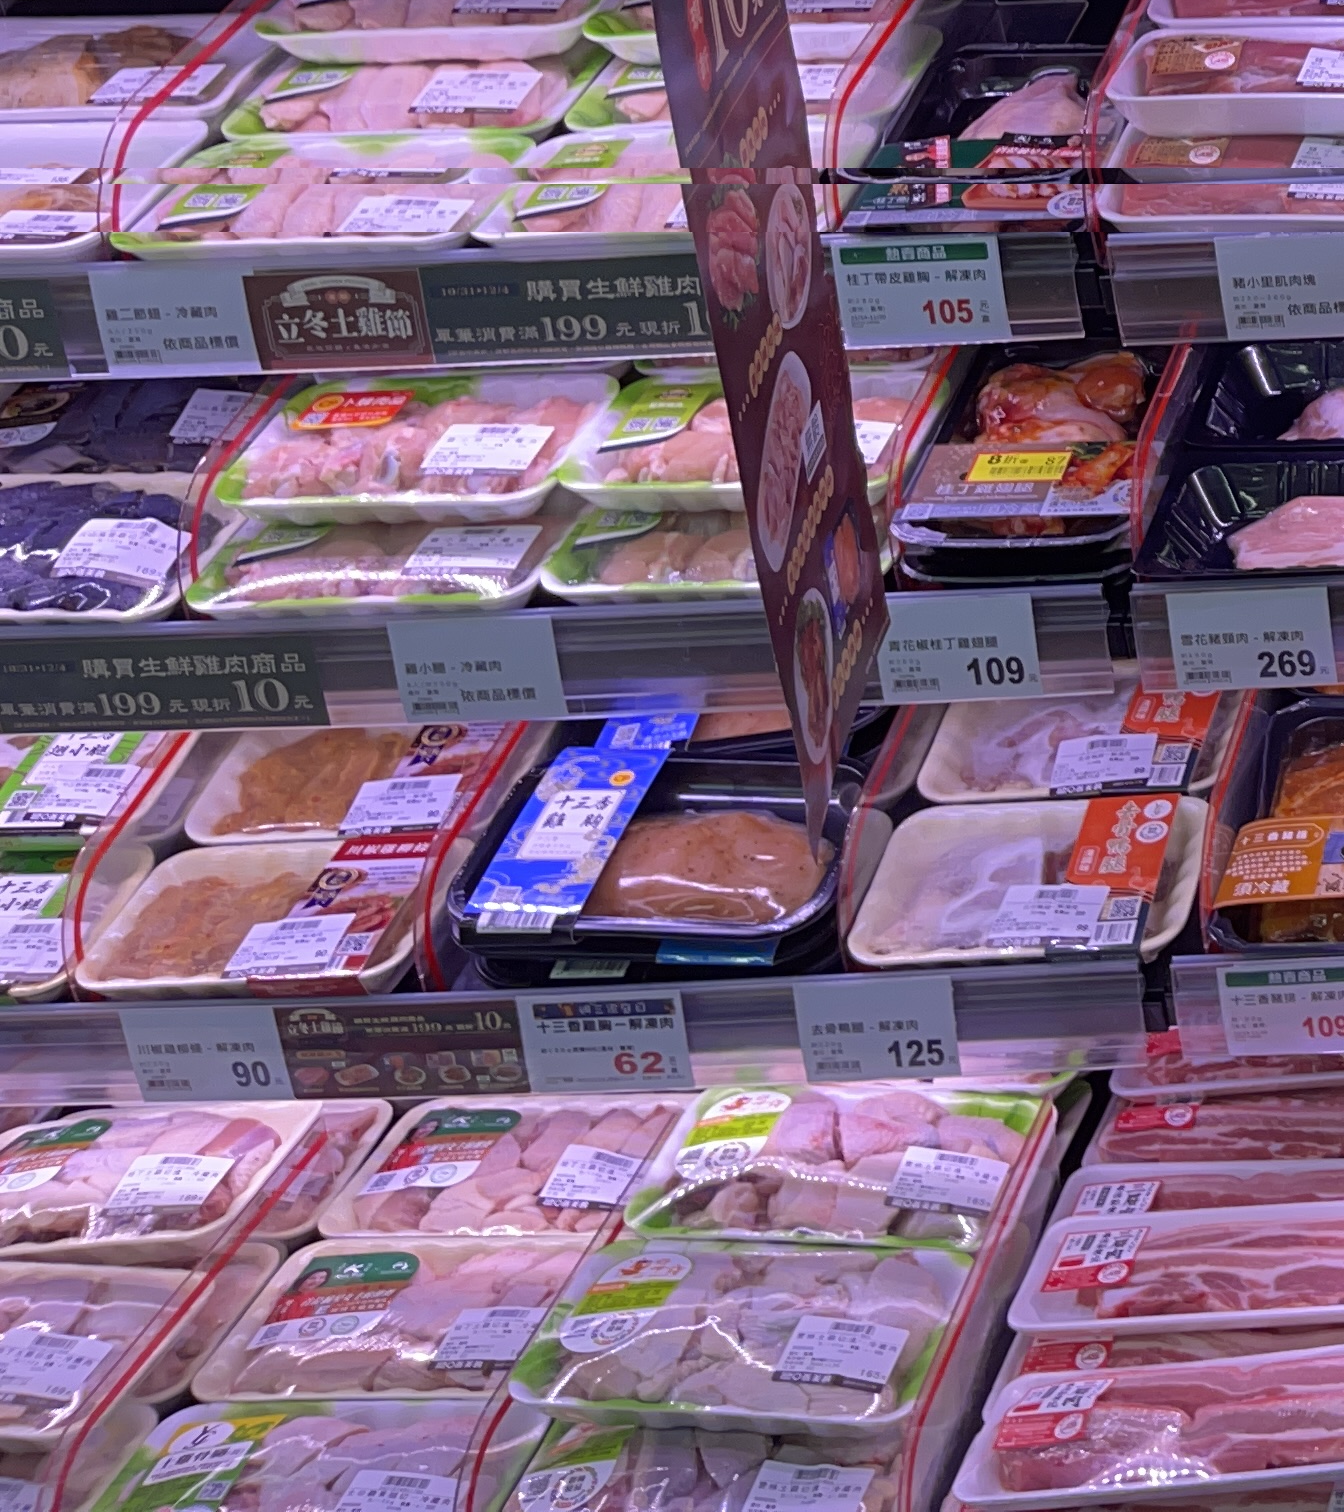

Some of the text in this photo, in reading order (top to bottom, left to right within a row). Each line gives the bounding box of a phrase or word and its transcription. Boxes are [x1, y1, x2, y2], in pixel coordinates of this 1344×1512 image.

[886, 246, 947, 261] 熱賣商品
[526, 274, 700, 302] 購買生鮮雞肉
[846, 268, 987, 286] 桂丁帶皮雞胸 解凍肉
[1232, 274, 1316, 289] 豬小里肌肉塊
[175, 306, 218, 319] 冷藏肉
[923, 299, 974, 325] 105
[275, 306, 413, 344] 立冬土雞節
[435, 325, 539, 343] 單筆消費滿
[540, 315, 607, 342] 199
[616, 322, 635, 337] 元
[640, 320, 680, 335] 現折
[163, 335, 239, 351] 依商品標價
[82, 652, 306, 680] 購買生鮮雞肉商品
[459, 660, 502, 673] 冷藏肉
[967, 656, 1025, 686] 109
[1257, 649, 1317, 678] 269
[98, 690, 162, 718] 199
[169, 698, 189, 714] 元
[191, 696, 230, 714] 現折
[232, 678, 291, 713] 10
[294, 692, 313, 710] 元
[461, 687, 537, 703] 依商品標價
[555, 794, 613, 810] 十三香
[537, 1017, 674, 1034] 十三香雞胸 解凍肉
[614, 1051, 665, 1075] 62
[888, 1039, 945, 1068] 125
[232, 1061, 270, 1087] 90
